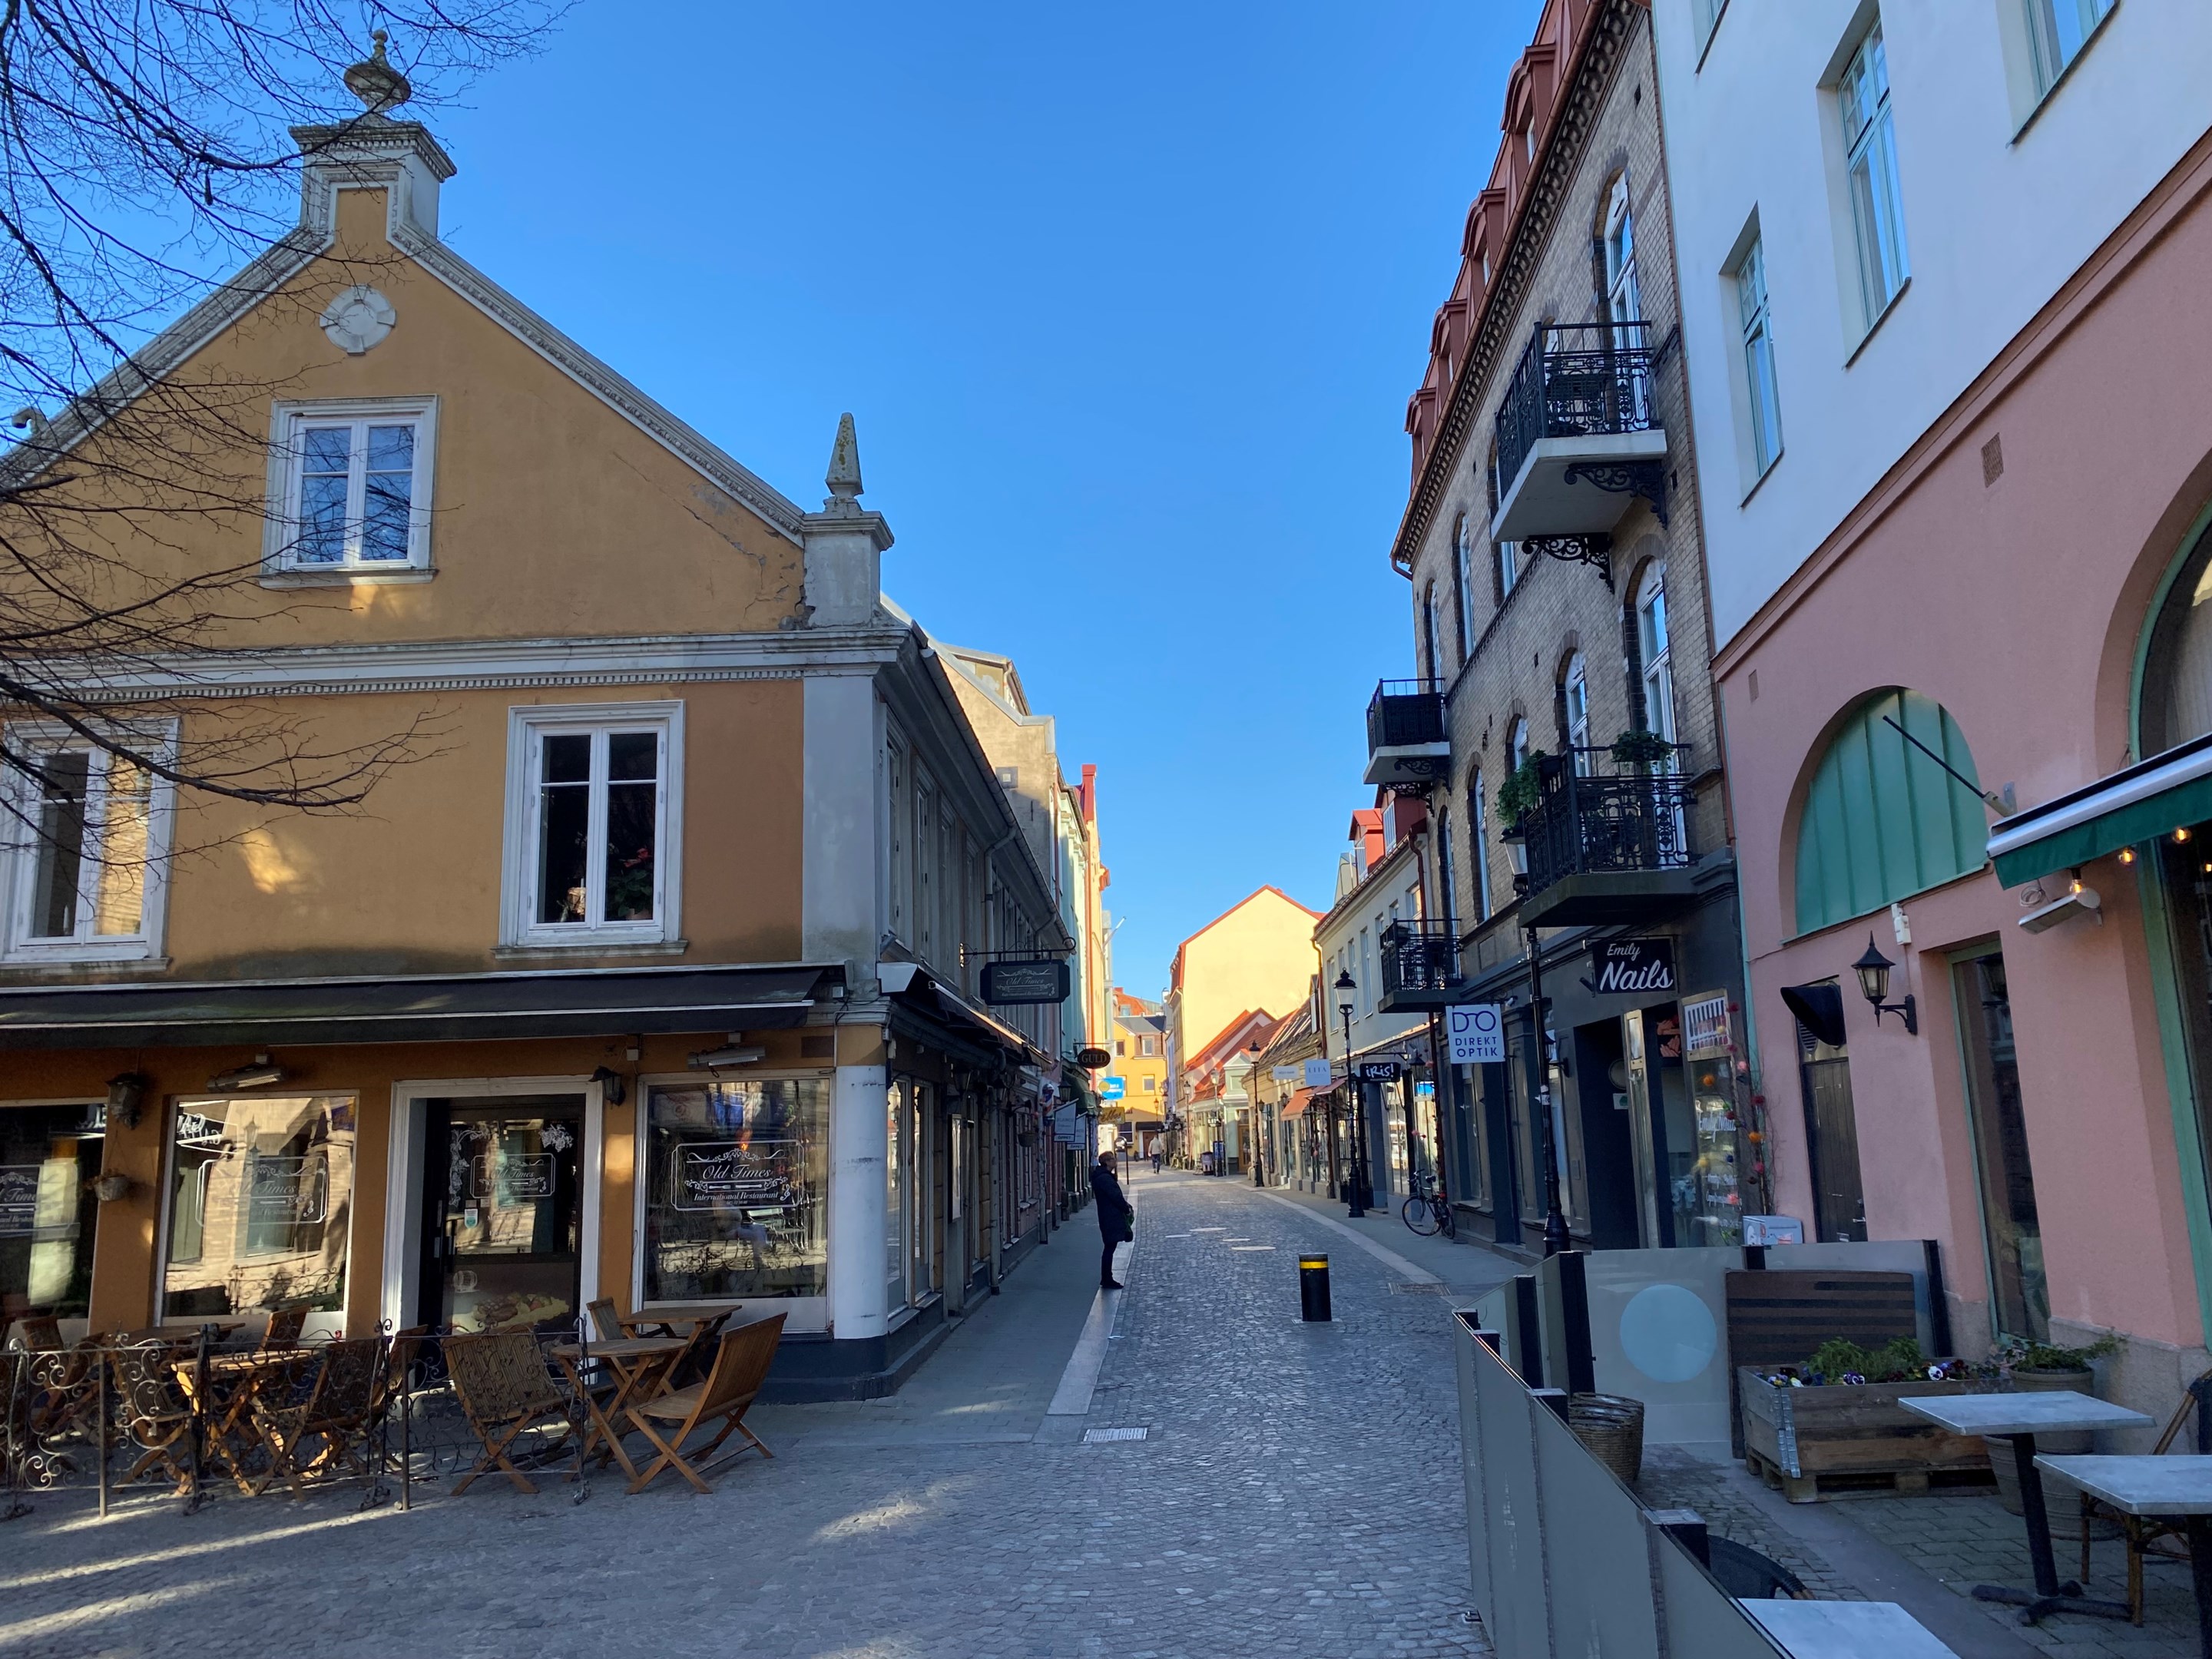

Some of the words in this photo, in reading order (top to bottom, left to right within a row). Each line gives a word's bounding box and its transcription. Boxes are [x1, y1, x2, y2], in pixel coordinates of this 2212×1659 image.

[1607, 942, 1641, 962] Emily
[1599, 959, 1674, 991] Nails
[1006, 976, 1022, 985] Old
[1022, 976, 1045, 985] Times
[1455, 1036, 1497, 1046] DIREKT
[1456, 1047, 1498, 1058] OPTIK
[1081, 1054, 1107, 1063] GULD
[508, 1167, 535, 1177] Times
[703, 1164, 728, 1179] Old
[730, 1164, 772, 1179] Times
[257, 1180, 297, 1194] Times
[694, 1192, 740, 1201] International
[740, 1191, 779, 1200] Restaurant
